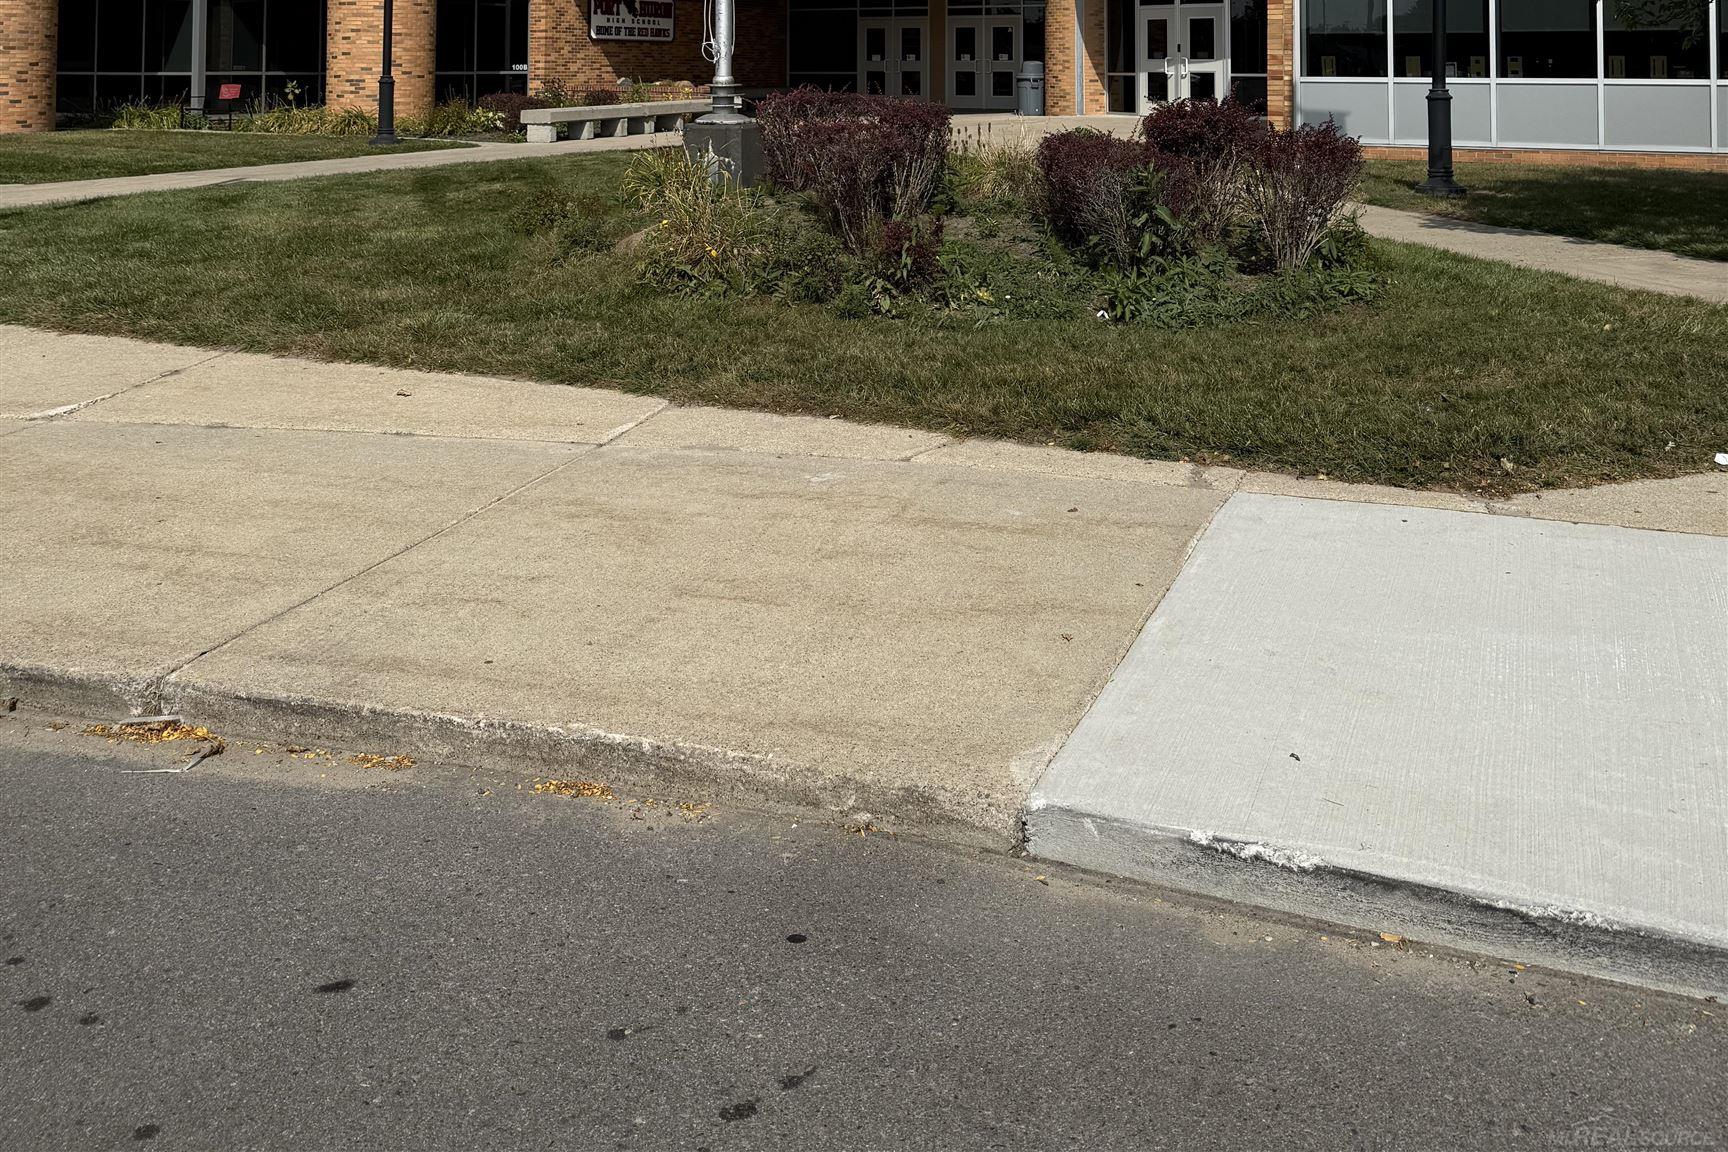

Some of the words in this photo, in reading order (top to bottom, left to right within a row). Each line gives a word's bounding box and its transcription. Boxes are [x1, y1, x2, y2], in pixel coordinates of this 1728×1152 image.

[639, 0, 673, 19] HURO
[606, 16, 626, 24] HIGH
[631, 18, 661, 26] SCHOOL
[596, 25, 613, 36] HOME
[614, 26, 623, 36] OF
[624, 27, 636, 37] THE
